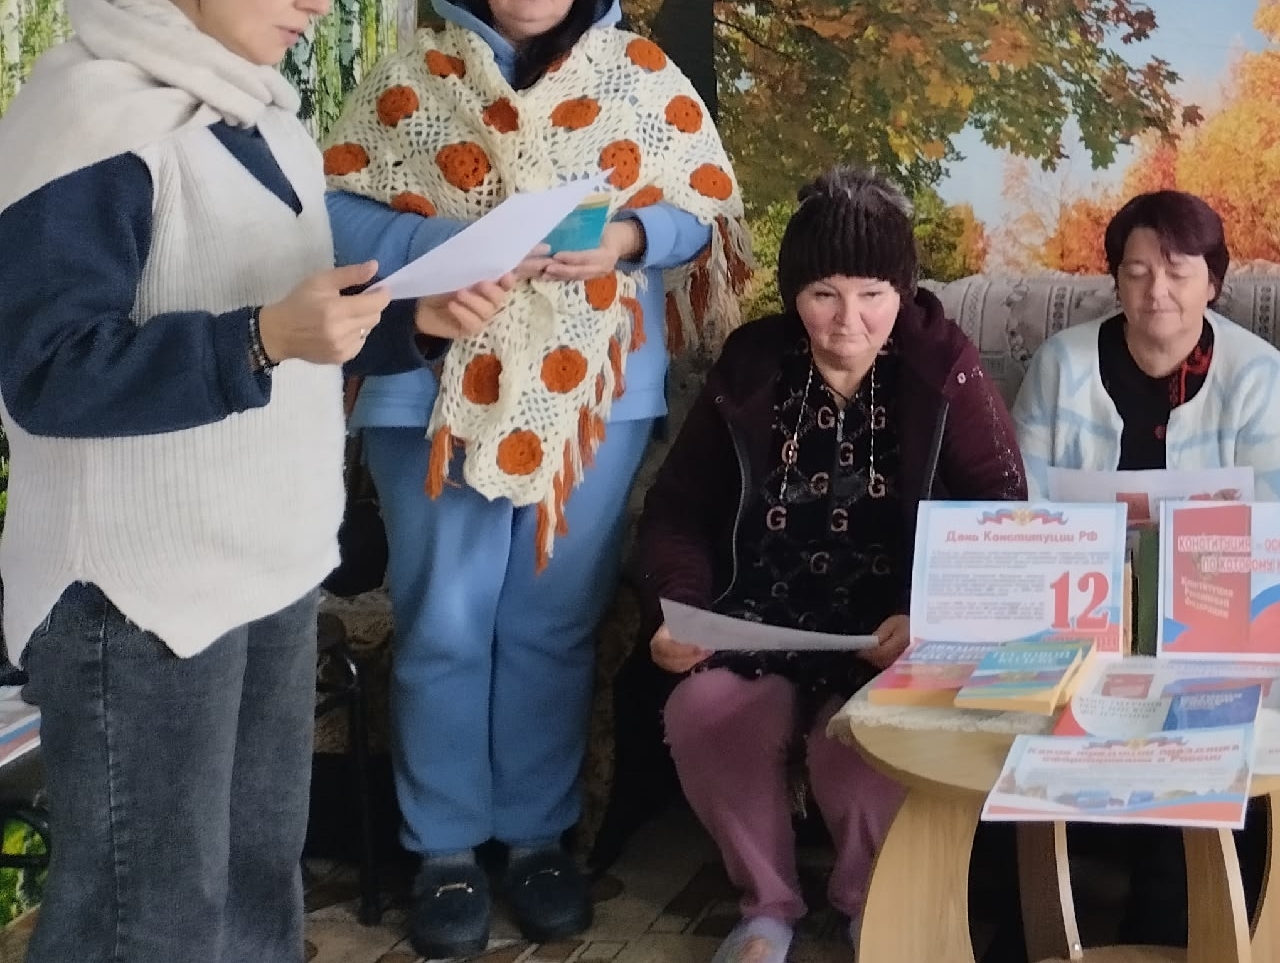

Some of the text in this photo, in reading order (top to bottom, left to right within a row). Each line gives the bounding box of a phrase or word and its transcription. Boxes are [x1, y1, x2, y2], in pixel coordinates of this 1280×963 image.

[766, 506, 787, 531] G
[830, 508, 849, 532] G
[983, 530, 1075, 544] Конституции
[1078, 530, 1099, 542] РФ
[1050, 569, 1109, 629] 12
